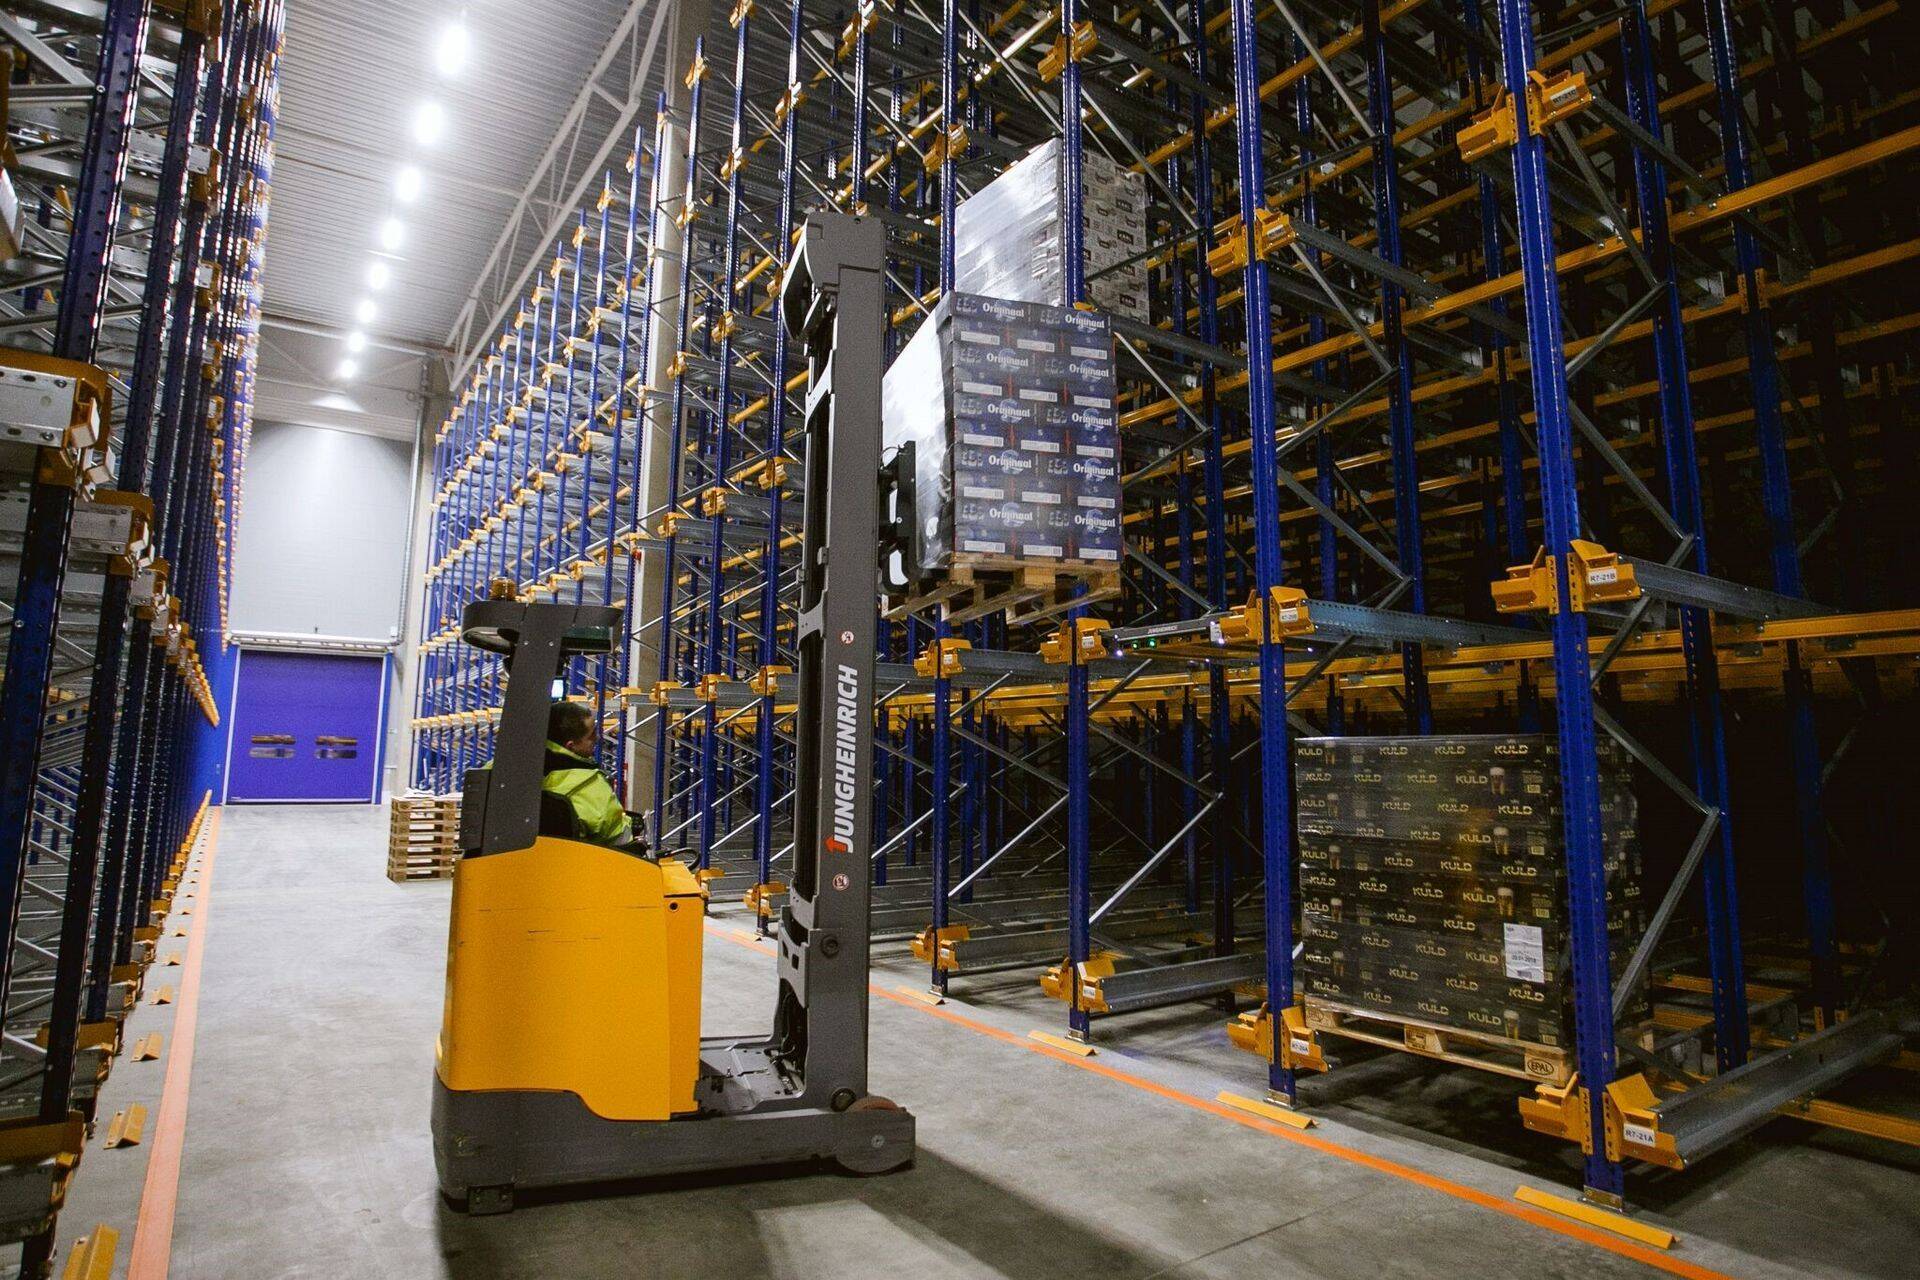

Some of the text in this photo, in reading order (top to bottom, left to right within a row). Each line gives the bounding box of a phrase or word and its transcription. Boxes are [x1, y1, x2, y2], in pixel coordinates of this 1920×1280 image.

[1380, 747, 1408, 755] KULD
[1434, 746, 1466, 754] KULD
[1494, 745, 1528, 754] KULD
[834, 664, 858, 853] JUNGHEINRICH
[1306, 773, 1332, 781] KULD
[1354, 774, 1382, 782] KULD
[1407, 774, 1437, 783] KULD
[1456, 775, 1488, 784] KULD
[1383, 802, 1411, 810] KULD
[1438, 804, 1469, 812] KULD
[1498, 805, 1532, 815] KULD
[1356, 827, 1384, 837] KULD
[1410, 831, 1440, 840] KULD
[1459, 833, 1491, 843] KULD
[1302, 850, 1327, 859] KULD
[1385, 857, 1413, 866] KULD
[1440, 861, 1472, 872] KULD
[1502, 865, 1537, 876] KULD
[1310, 877, 1336, 886] KULD
[1360, 882, 1387, 892] KULD
[1412, 888, 1444, 898] KULD
[1463, 892, 1496, 903] KULD
[1304, 902, 1329, 912] KULD
[1387, 913, 1416, 923] KULD
[1443, 919, 1476, 931] KULD
[1312, 928, 1338, 939] KULD
[1361, 935, 1391, 948] KULD
[1416, 944, 1447, 956] KULD
[1305, 953, 1331, 964] KULD
[1466, 952, 1499, 964] KULD
[1389, 968, 1419, 980] KULD
[1313, 980, 1340, 992] KULD
[1446, 978, 1478, 991] KULD
[1364, 991, 1392, 1004] KULD
[1509, 988, 1545, 1002] KULD
[1418, 1002, 1449, 1015] KULD
[1468, 1011, 1502, 1025] KULD
[1531, 1061, 1550, 1072] EPAL
[1625, 1129, 1654, 1142] R7-21A
